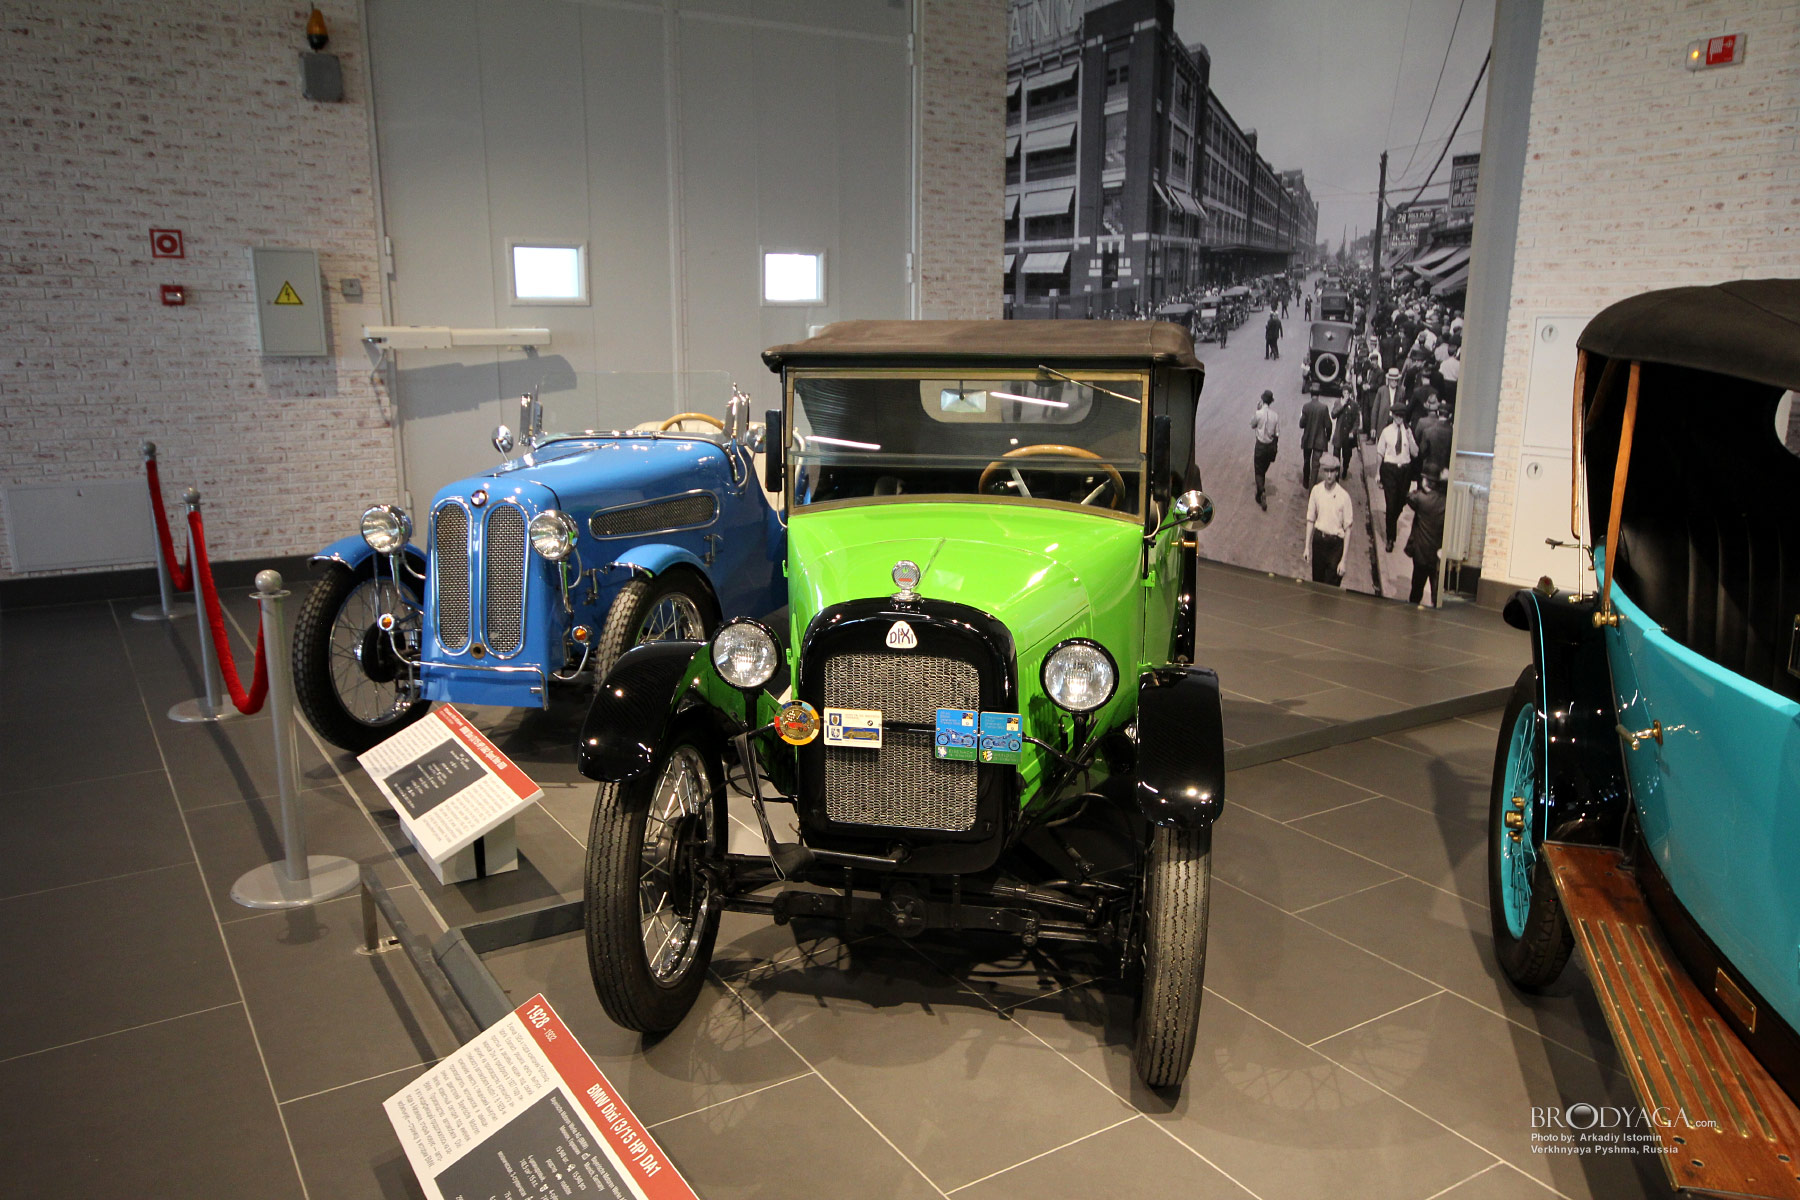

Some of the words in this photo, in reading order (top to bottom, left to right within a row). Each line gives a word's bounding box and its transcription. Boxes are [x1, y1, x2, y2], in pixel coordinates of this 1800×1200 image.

[526, 1005, 550, 1028] 1928
[587, 1083, 611, 1107] BMW
[601, 1102, 621, 1123] Dixi
[610, 1118, 637, 1144] (3/15
[628, 1138, 648, 1161] HP)
[639, 1154, 662, 1177] DA1
